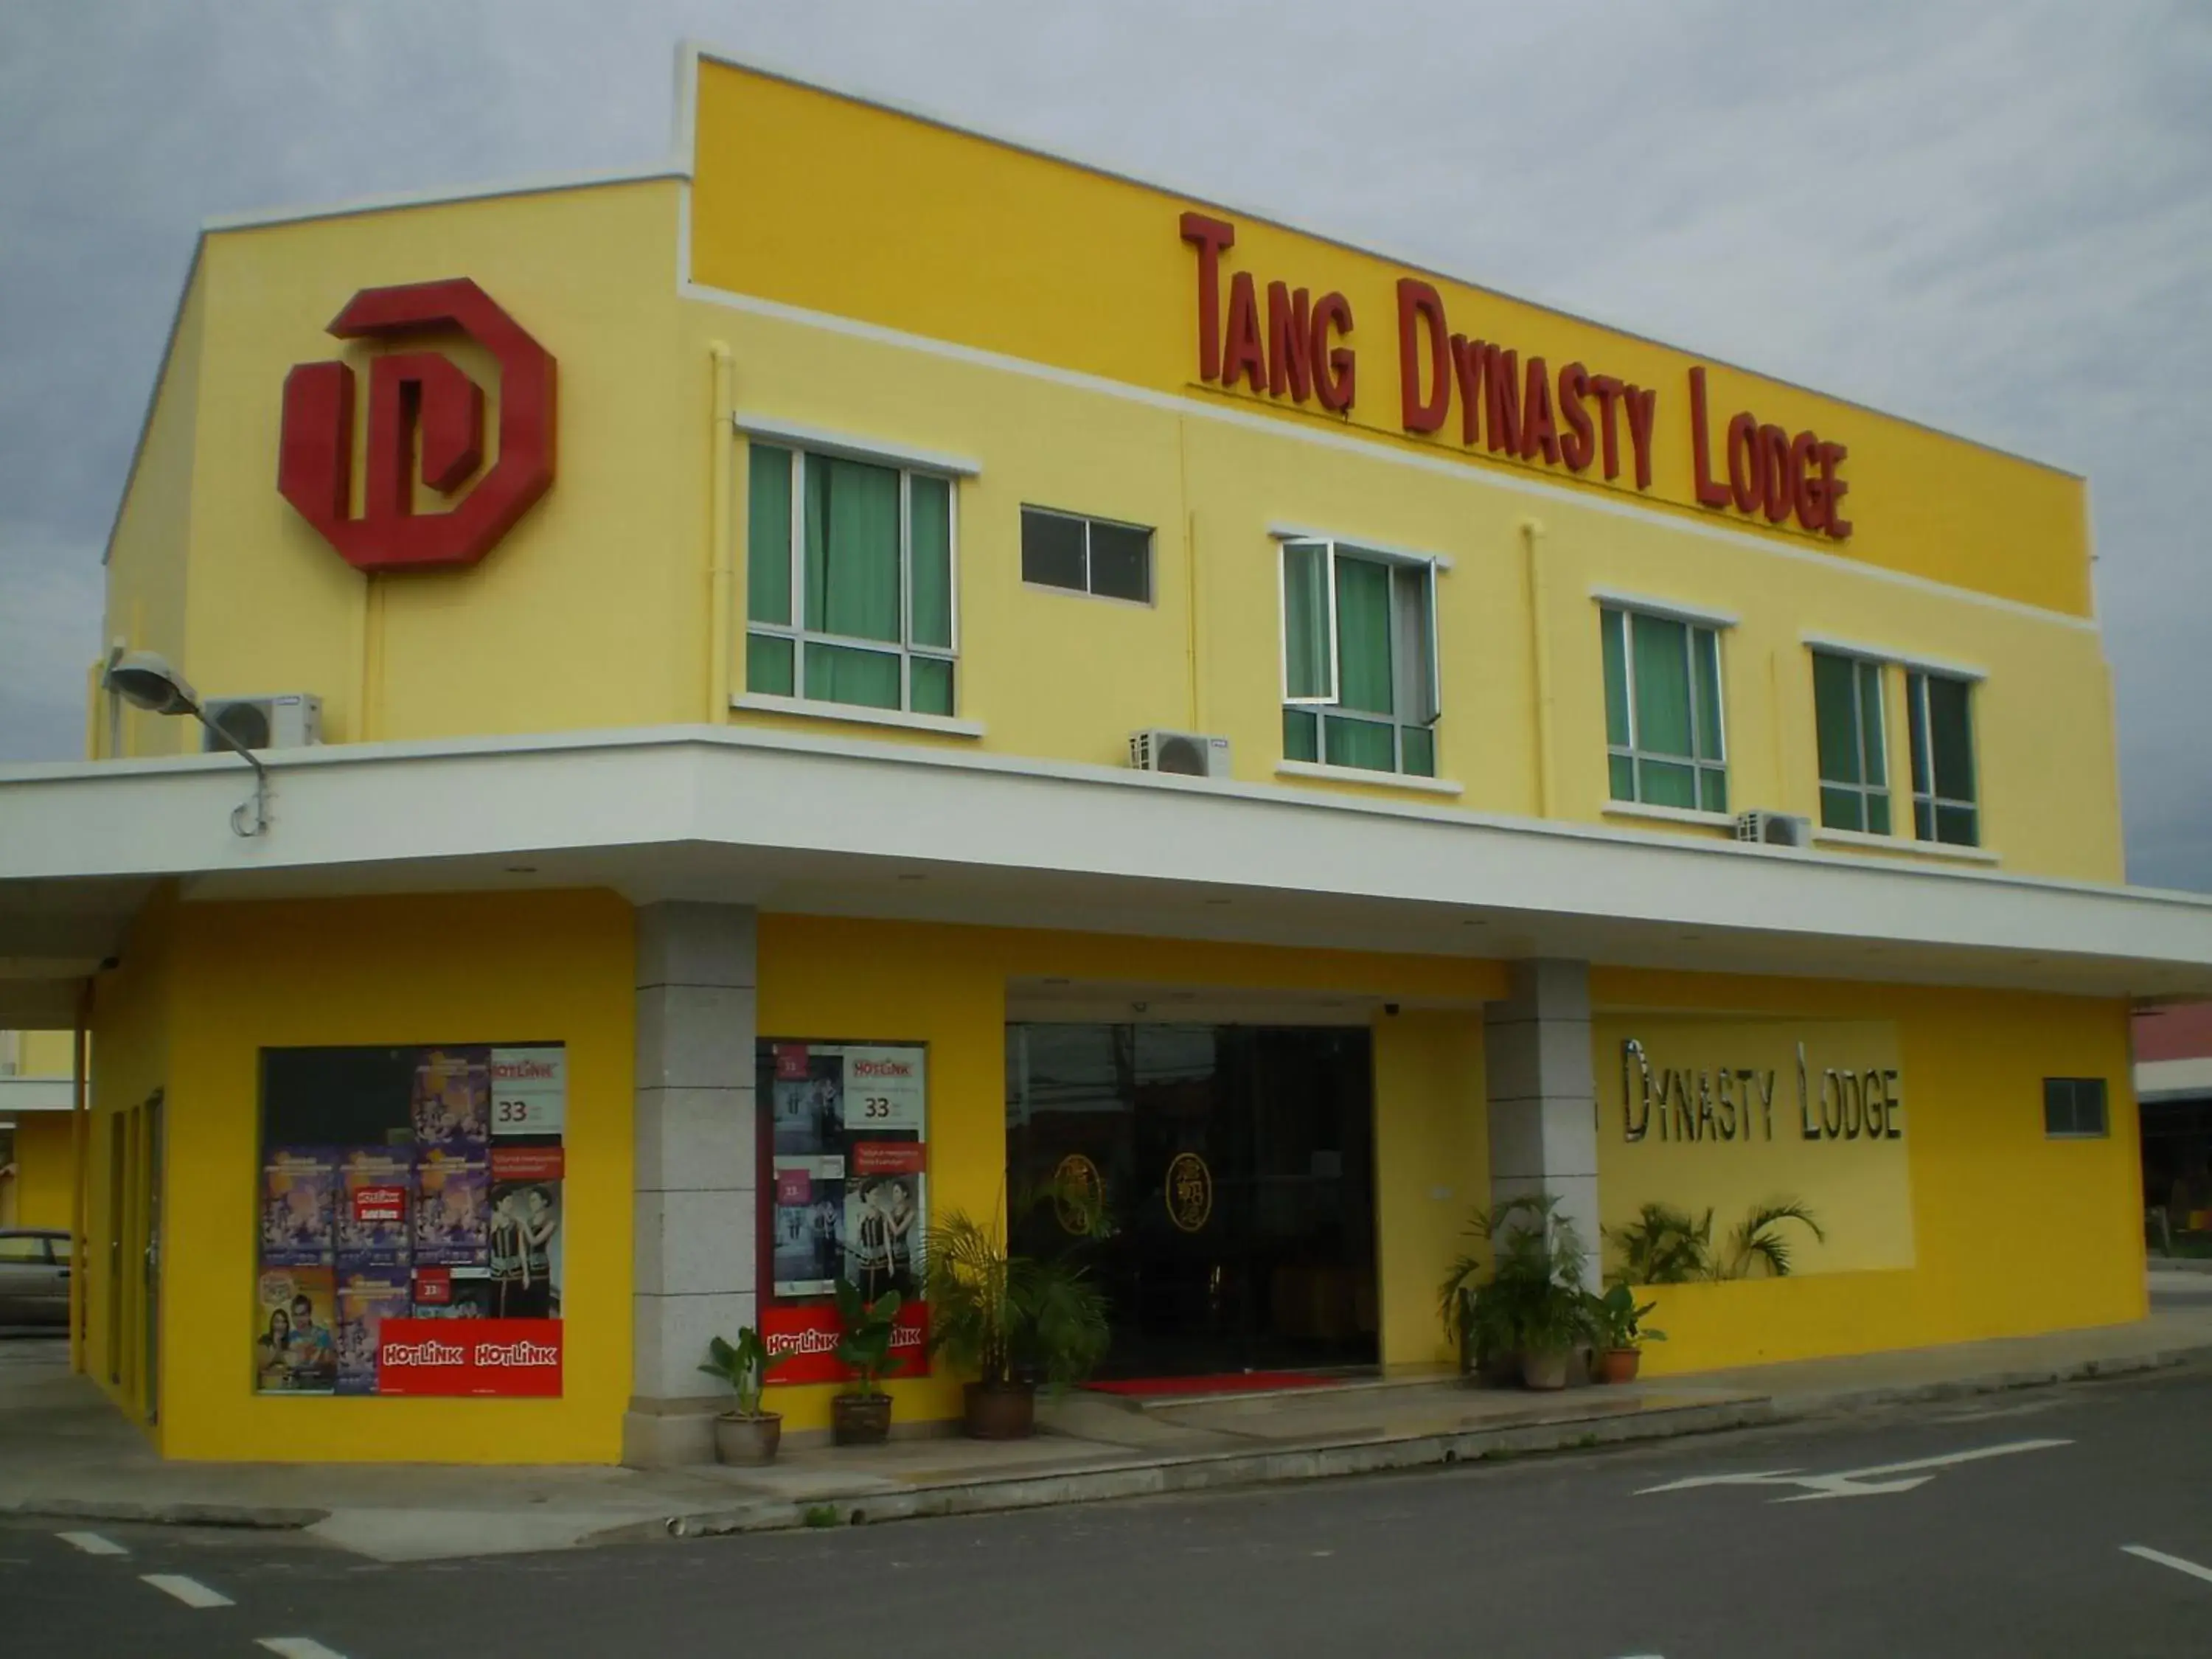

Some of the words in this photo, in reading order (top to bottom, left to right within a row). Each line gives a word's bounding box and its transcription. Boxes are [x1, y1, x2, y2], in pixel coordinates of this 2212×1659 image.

[1179, 211, 1355, 411] TANG
[1397, 277, 1657, 492] DYNASTY
[1688, 366, 1852, 540] LODGE
[498, 1101, 527, 1122] 33
[865, 1097, 890, 1118] 33
[1622, 1038, 1775, 1143] DYNASTY
[1797, 1041, 1902, 1141] LODGE
